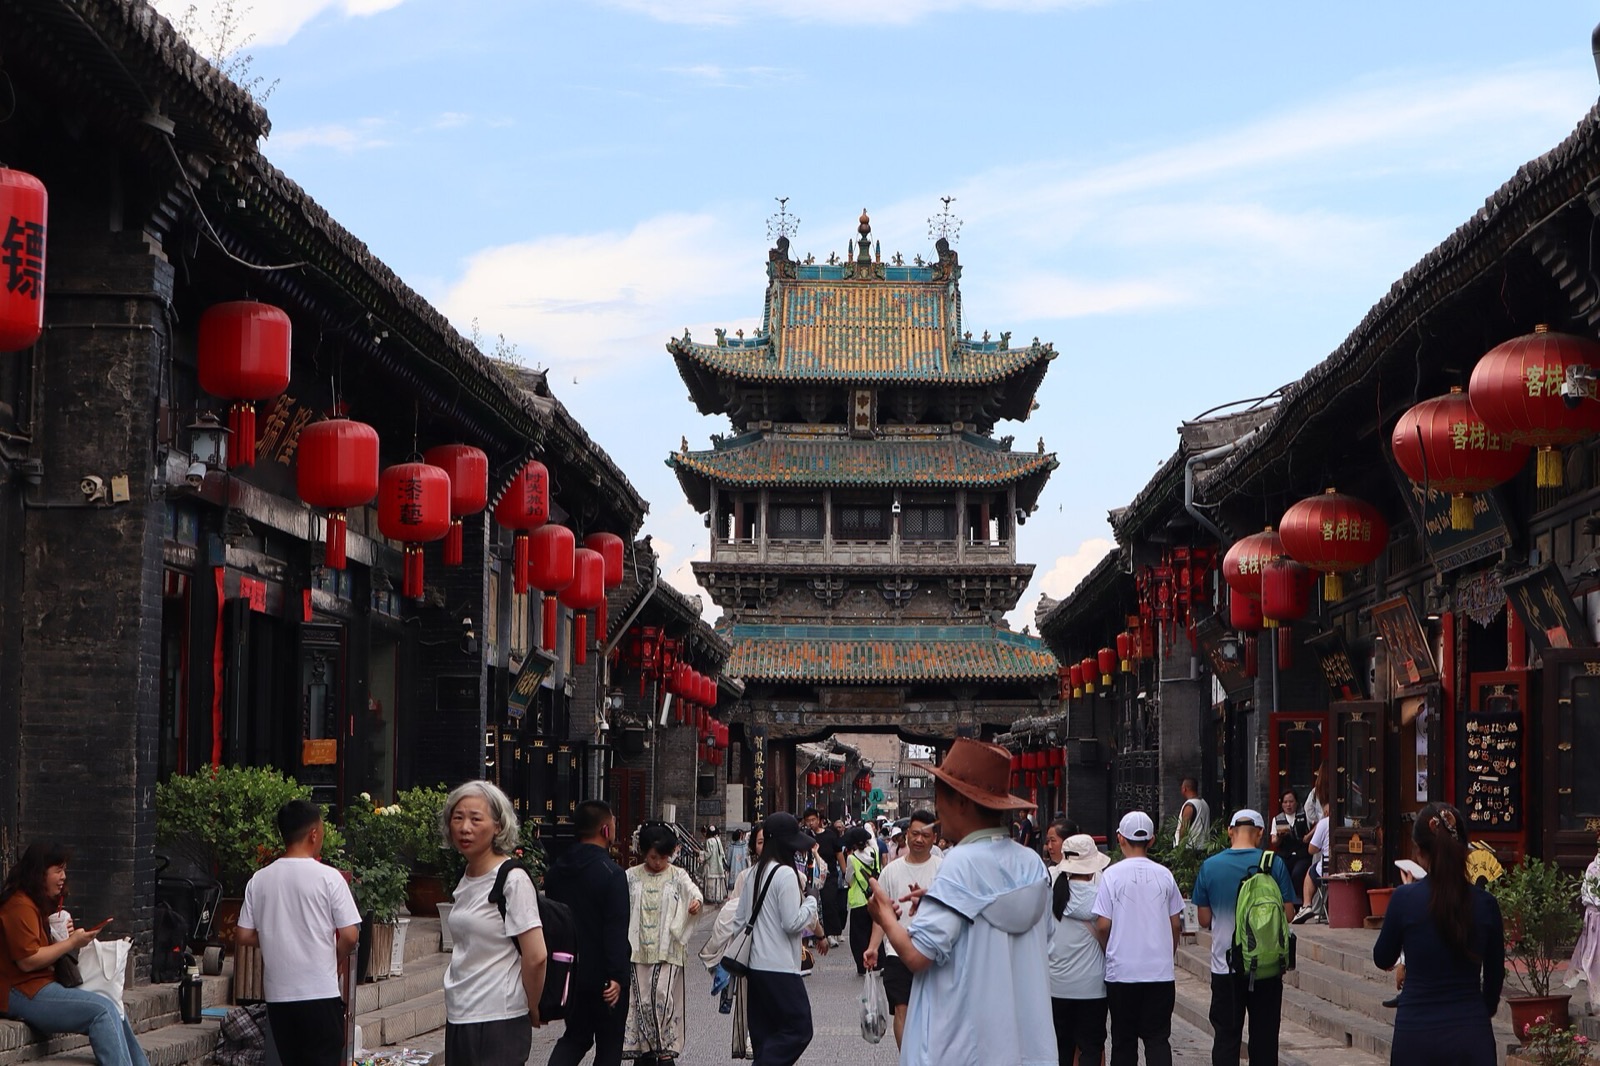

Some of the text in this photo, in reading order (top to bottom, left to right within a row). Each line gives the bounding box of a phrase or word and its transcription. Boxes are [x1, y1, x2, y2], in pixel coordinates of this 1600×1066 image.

[1, 215, 45, 300] 镖
[1322, 518, 1371, 541] 客栈住宿
